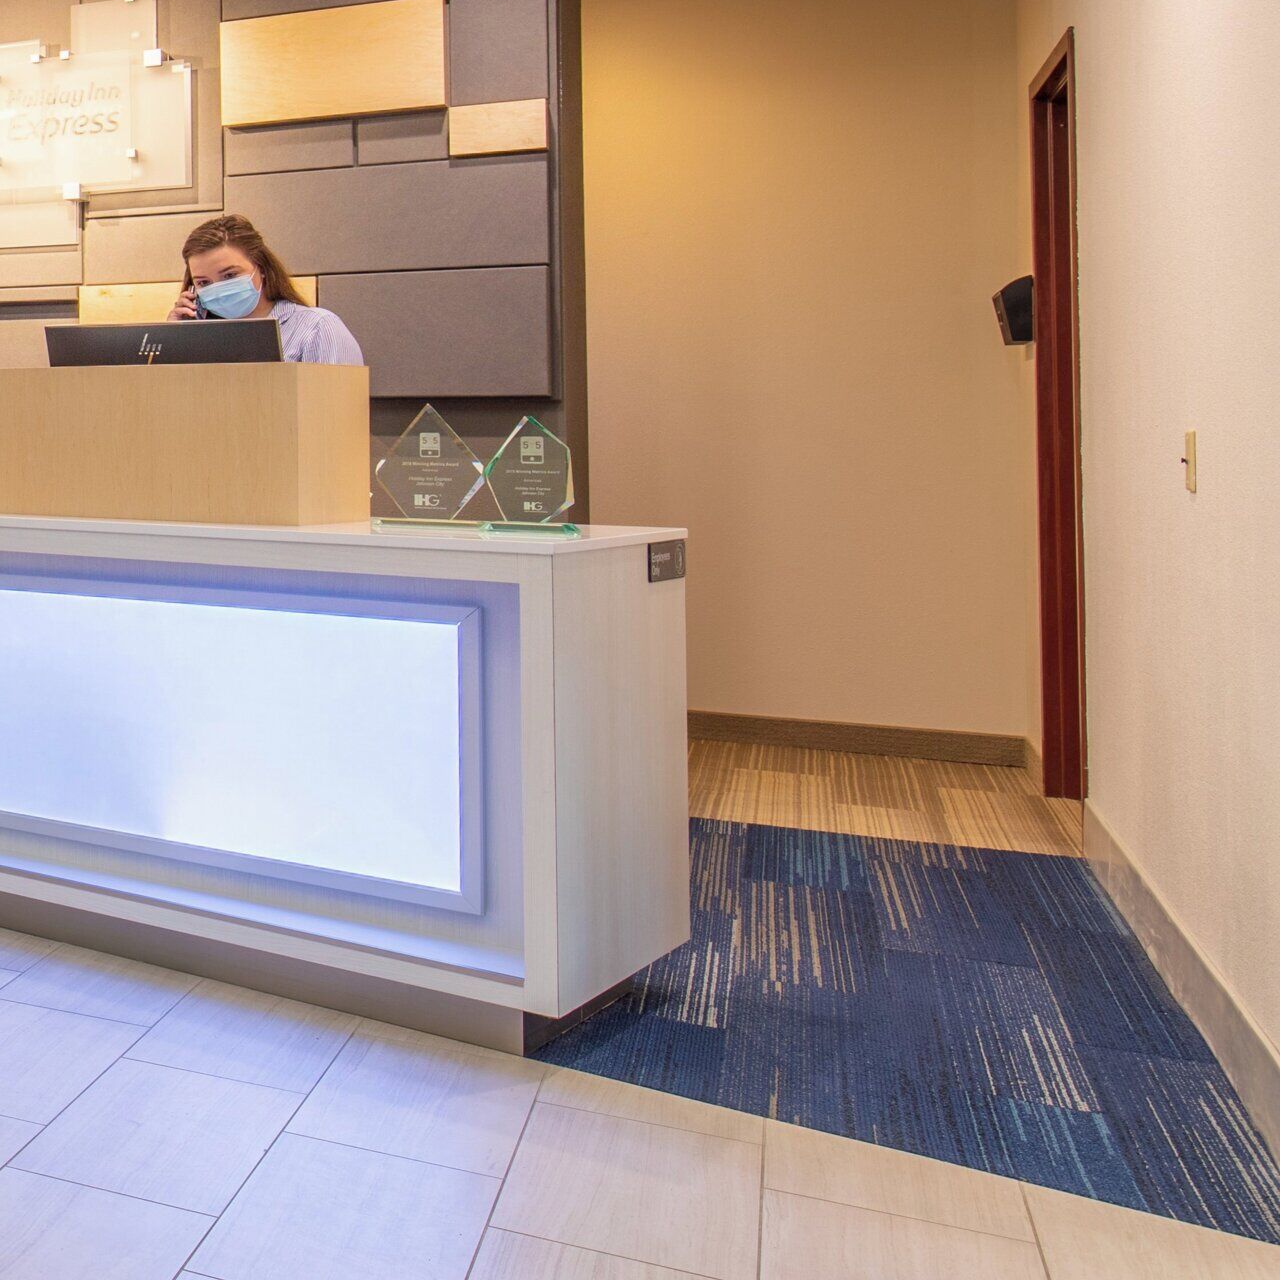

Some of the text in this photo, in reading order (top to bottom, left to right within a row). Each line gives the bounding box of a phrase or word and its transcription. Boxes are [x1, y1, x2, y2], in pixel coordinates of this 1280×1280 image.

[88, 81, 121, 101] Inn
[9, 111, 120, 145] Express
[414, 494, 440, 506] IHG
[523, 501, 543, 511] IHG
